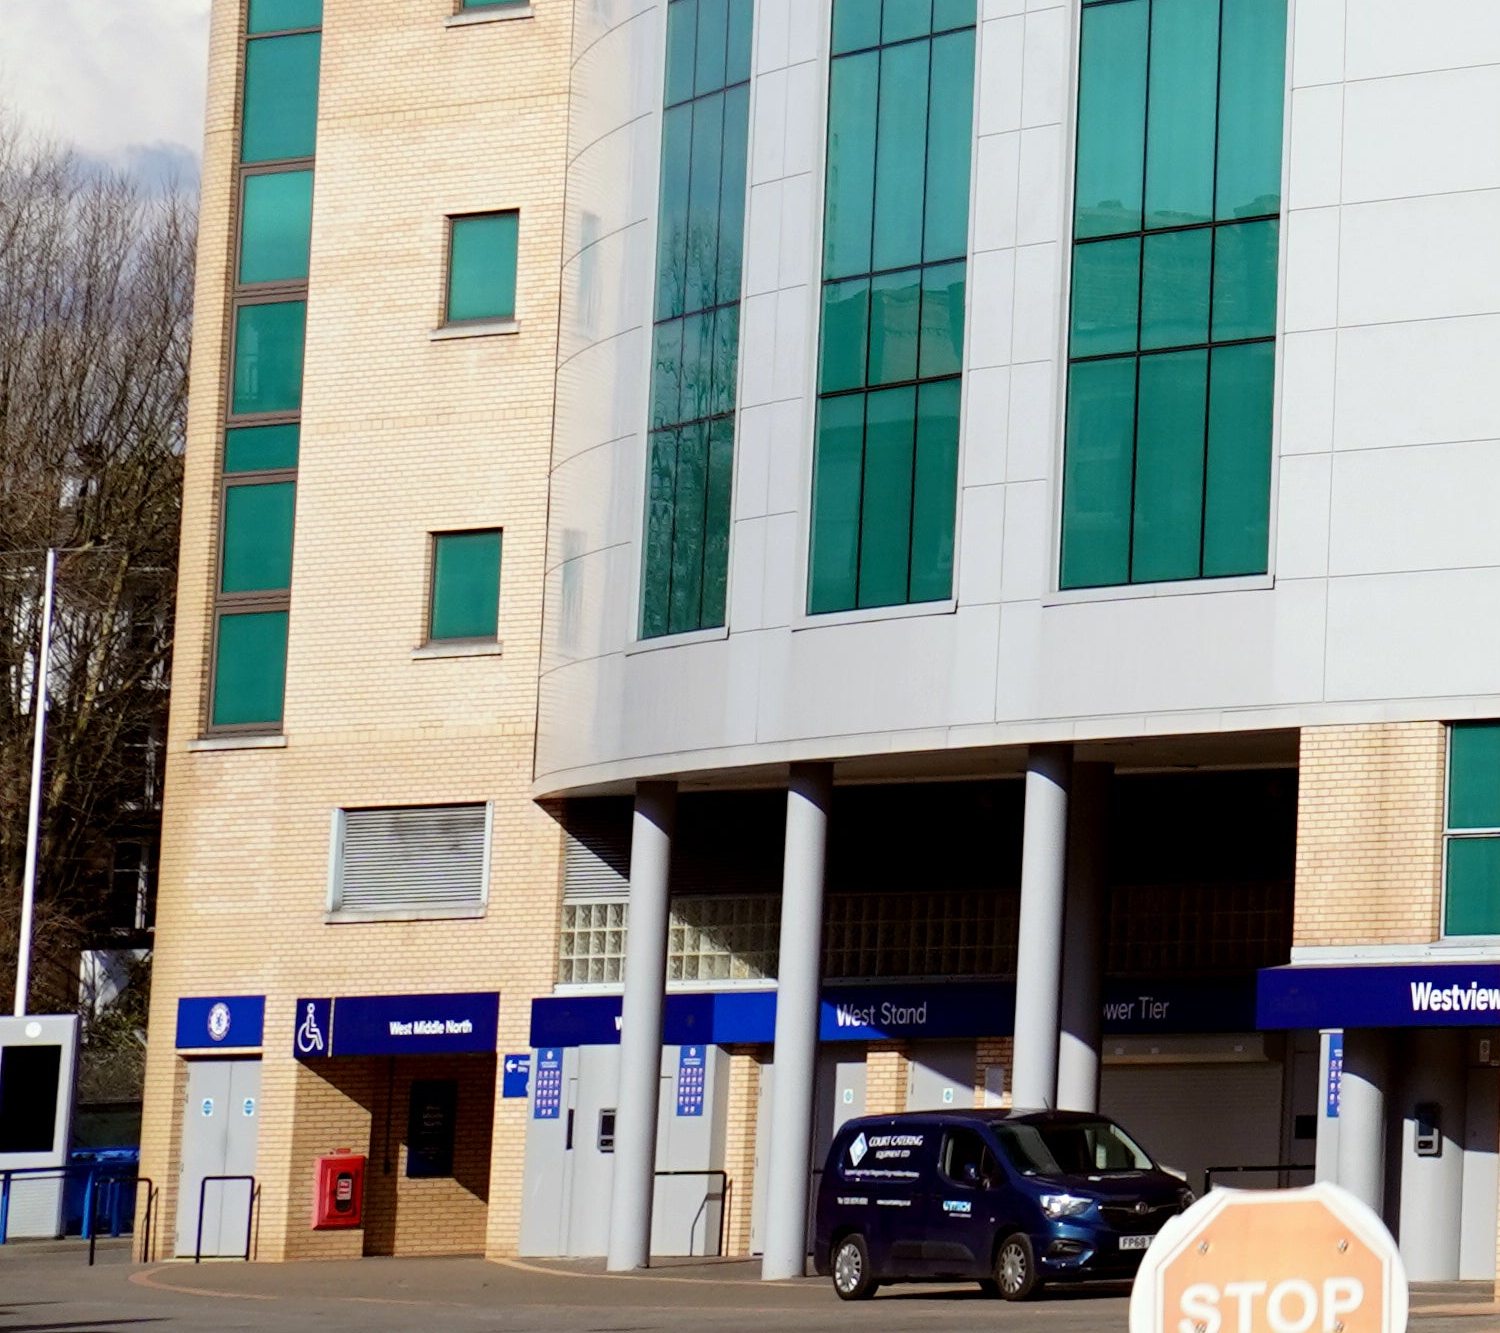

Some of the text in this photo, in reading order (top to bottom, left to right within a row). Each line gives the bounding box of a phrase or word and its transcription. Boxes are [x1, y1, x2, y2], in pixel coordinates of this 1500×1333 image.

[389, 1019, 472, 1035] West Middle North
[836, 1004, 876, 1027] West
[881, 1001, 927, 1025] Stand
[1138, 995, 1170, 1020] Tier
[1178, 1276, 1364, 1333] STOP
